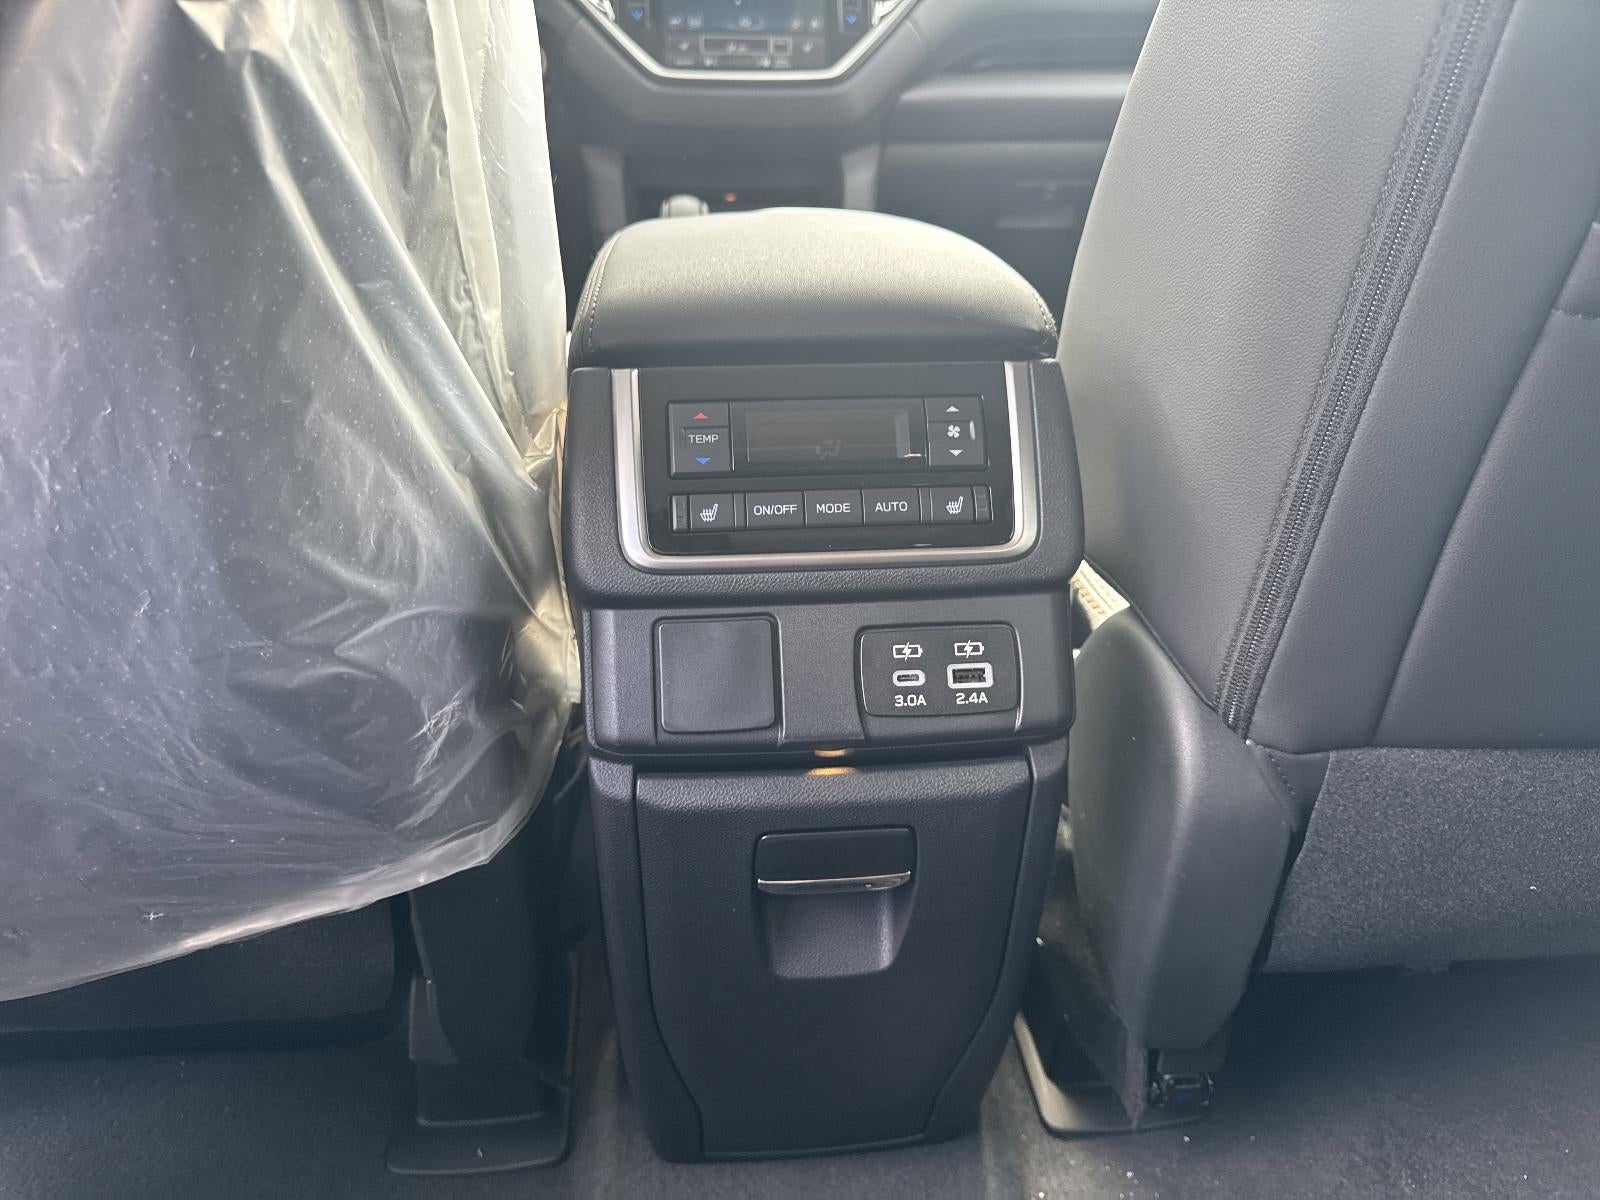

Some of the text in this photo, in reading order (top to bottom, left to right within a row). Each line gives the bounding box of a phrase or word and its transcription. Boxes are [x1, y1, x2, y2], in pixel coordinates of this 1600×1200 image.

[688, 433, 719, 444] TEMP
[753, 503, 798, 516] ON/OFF
[816, 502, 851, 513] MODE
[875, 501, 908, 512] AUTO
[894, 694, 927, 707] 3.0A
[955, 691, 989, 705] 2.4A
